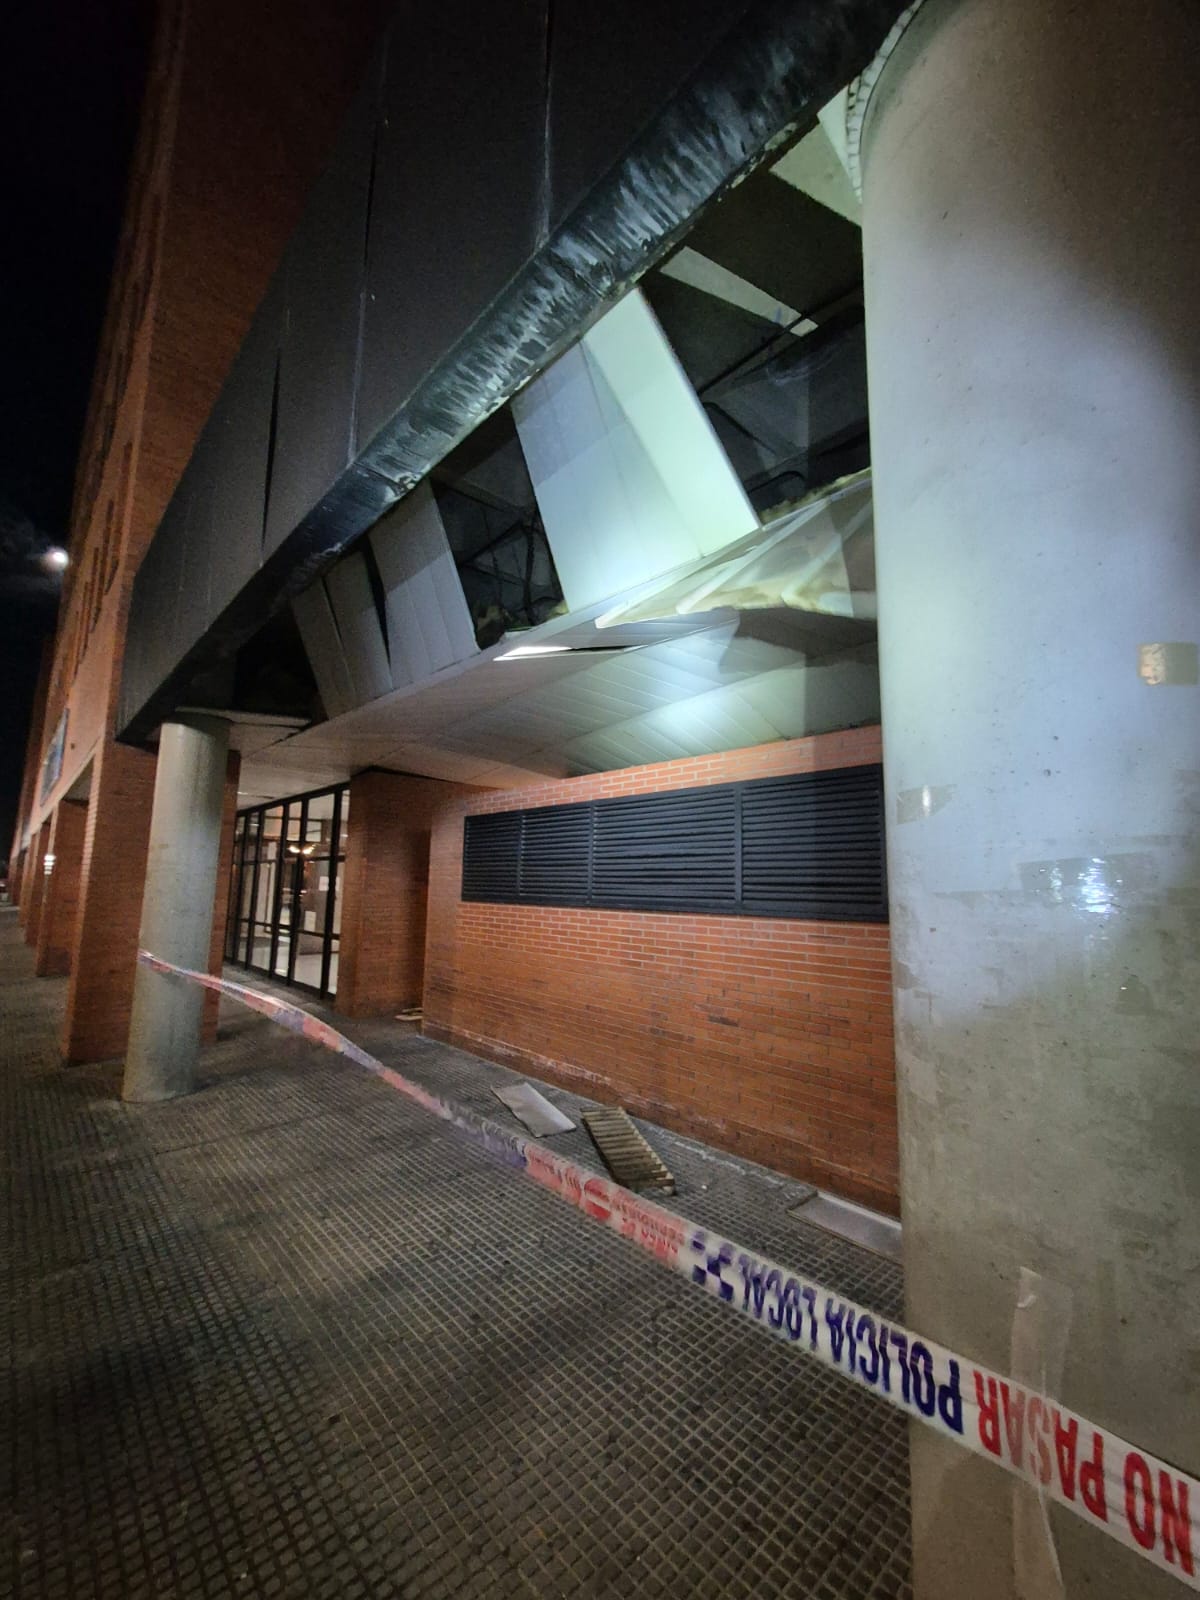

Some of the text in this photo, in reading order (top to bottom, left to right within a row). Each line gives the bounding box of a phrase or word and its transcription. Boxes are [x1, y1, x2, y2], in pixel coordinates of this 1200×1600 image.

[739, 1253, 1194, 1576] NO PASAR POLICIA LOCAL
